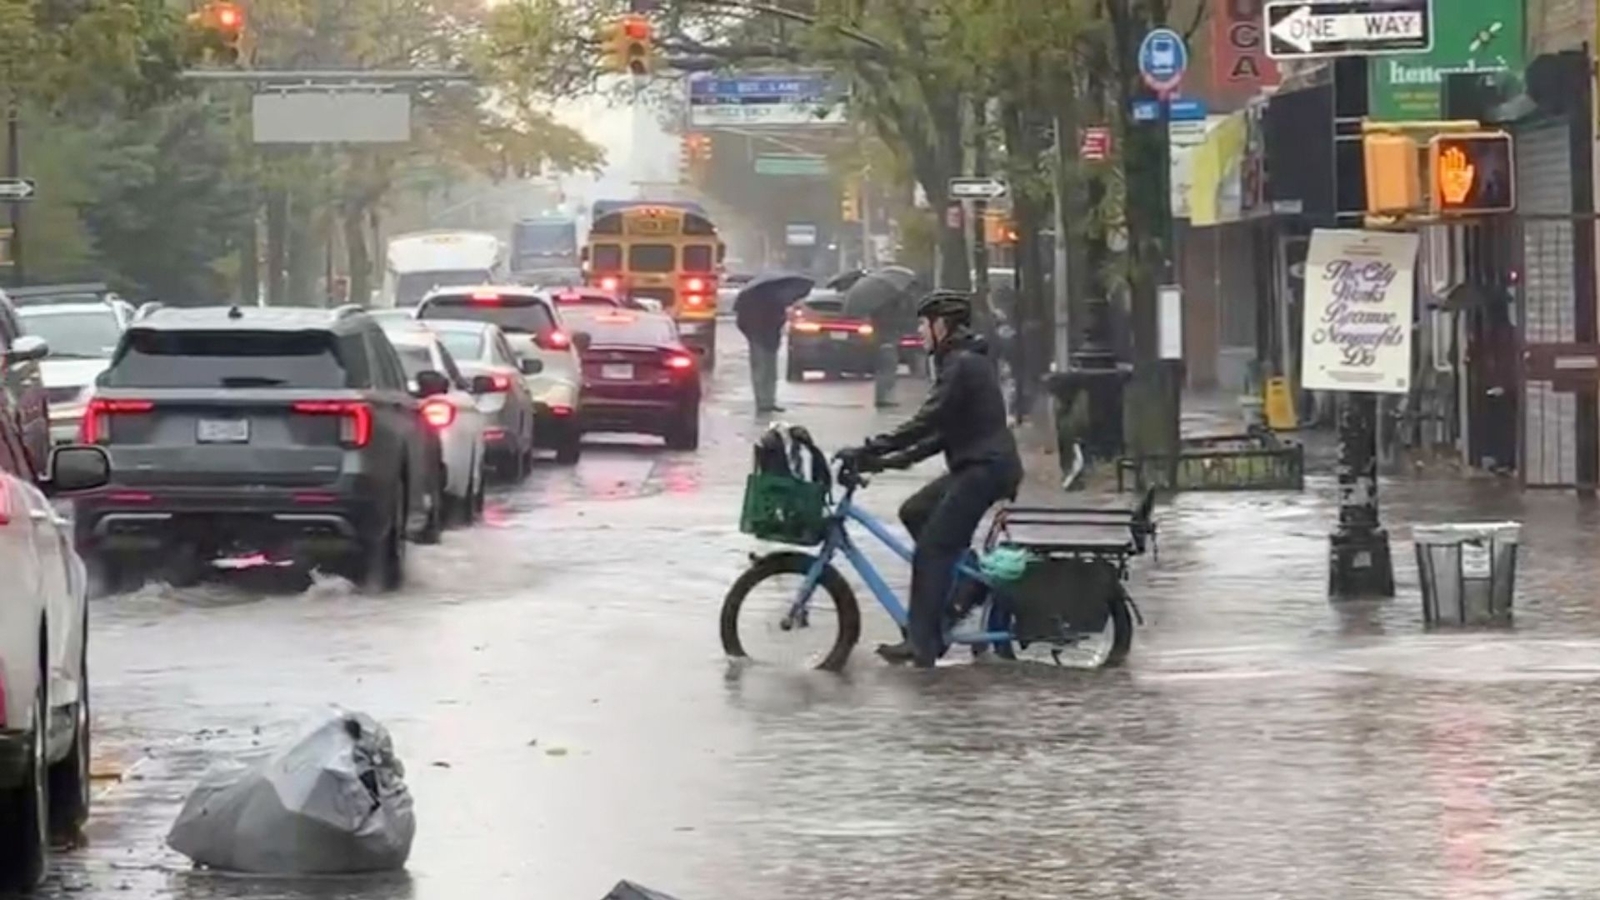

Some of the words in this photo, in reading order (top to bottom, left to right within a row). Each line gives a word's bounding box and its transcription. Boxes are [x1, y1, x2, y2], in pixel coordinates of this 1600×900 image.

[1290, 18, 1335, 39] ONE
[1365, 16, 1414, 35] WAY
[1323, 260, 1362, 281] The
[1362, 261, 1397, 289] City
[1331, 280, 1386, 303] Works
[1320, 301, 1397, 327] Because
[1311, 324, 1404, 350] Nonprofits
[1339, 345, 1376, 367] Do
